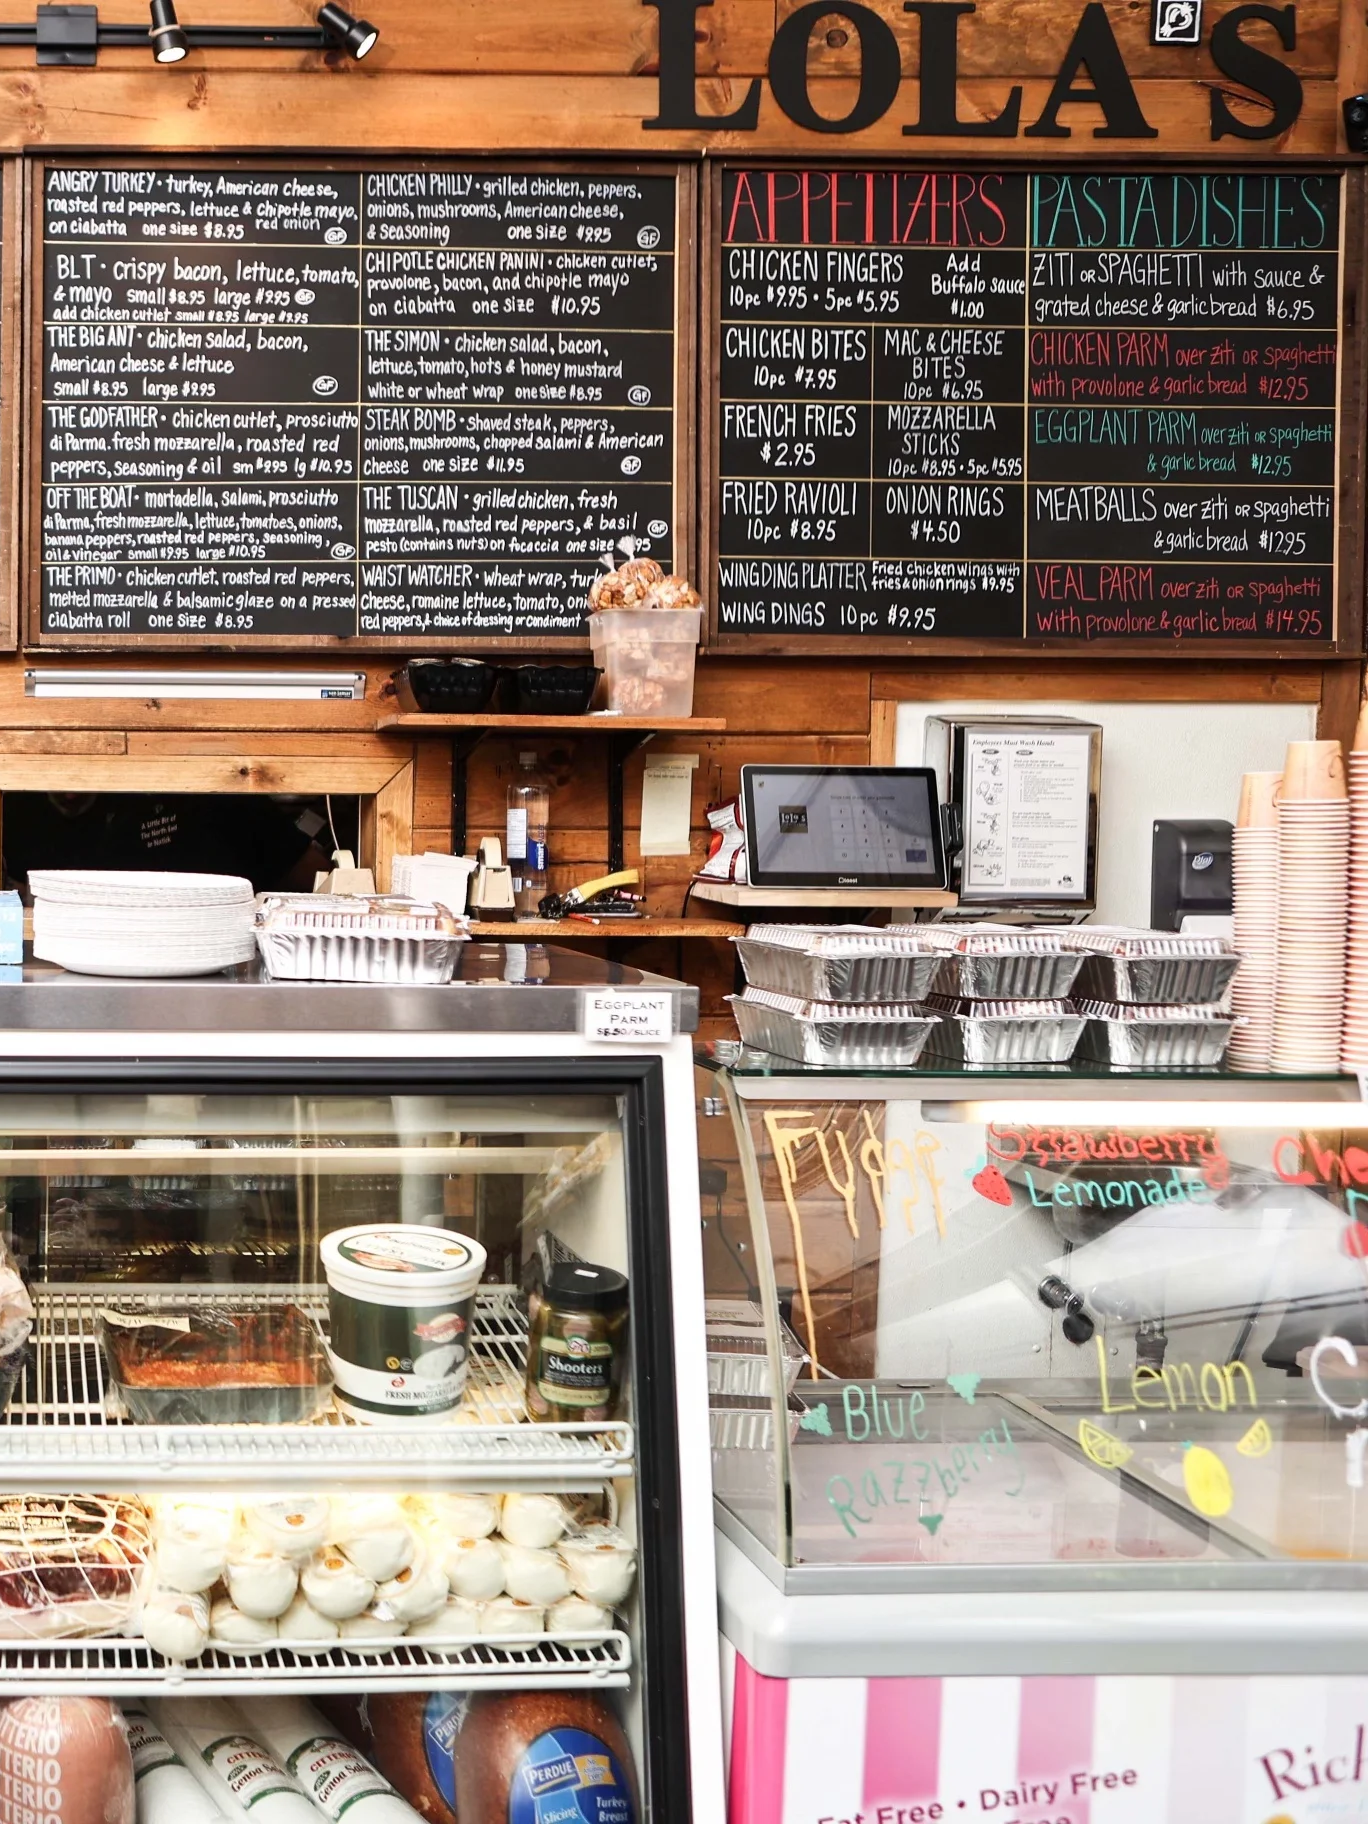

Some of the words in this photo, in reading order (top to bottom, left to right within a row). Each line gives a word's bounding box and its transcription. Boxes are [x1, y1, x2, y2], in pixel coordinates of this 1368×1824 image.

[47, 172, 98, 193] ANGRY
[102, 172, 155, 193] TURKEY
[166, 175, 213, 198] turkey,
[216, 179, 277, 196] American
[283, 179, 338, 199] cheese,
[367, 174, 426, 197] CHICKEN
[430, 174, 472, 197] PHILLY
[483, 176, 527, 198] grilled
[531, 176, 585, 198] chicken,
[588, 182, 642, 200] peppers,
[725, 171, 1006, 246] APPETIZERS
[1032, 175, 1165, 247] PASTA
[1170, 176, 1324, 248] DISHES
[57, 254, 96, 280] BLT
[113, 258, 166, 284] crispy
[173, 257, 228, 285] bacon,
[237, 260, 300, 285] lettuce,
[301, 264, 360, 288] tomato,
[366, 252, 433, 274] CHIPOTLE
[437, 252, 495, 271] CHICKEN
[499, 252, 543, 270] PANINI
[729, 249, 818, 282] CHICKEN
[827, 252, 903, 283] FINGERS
[1032, 253, 1074, 288] ZITI
[1097, 253, 1203, 288] SPAGHETTI
[1212, 260, 1247, 288] with
[1254, 267, 1305, 289] sauce
[1308, 265, 1325, 284] &
[726, 327, 805, 360] CHICKEN
[811, 329, 867, 362] BITES
[754, 365, 786, 387] 10pc
[795, 366, 837, 390] $7.95
[365, 409, 410, 431] STEAK
[415, 408, 456, 432] BOMB
[724, 404, 796, 438] FRENCH
[805, 405, 857, 437] FRIES
[887, 405, 996, 431] MOZZARELLA
[760, 442, 816, 466] $2.95
[901, 432, 960, 456] STICKS
[363, 487, 392, 511] THE
[397, 485, 458, 511] TUSCAN
[723, 481, 777, 515] FRIED
[785, 482, 857, 516] RAVIOLI
[886, 486, 942, 515] ONION
[947, 487, 1004, 516] RINGS
[1036, 486, 1157, 523] MEATBALLS
[1163, 500, 1197, 519] over
[910, 520, 961, 544] $4.50
[48, 611, 103, 628] ciabatta
[108, 612, 130, 628] roll
[149, 614, 174, 627] one
[178, 613, 206, 628] size
[215, 613, 253, 628] $8.95
[594, 1000, 665, 1009] EGGPLANT
[610, 1015, 648, 1024] PARM
[1025, 1167, 1208, 1209] Lemonade
[548, 1356, 603, 1374] Shooters
[1095, 1334, 1257, 1413] Lemon
[842, 1385, 926, 1442] Blue
[528, 1761, 574, 1785] PERDUE
[979, 1782, 1059, 1811] Dairy
[1070, 1768, 1138, 1795] Free
